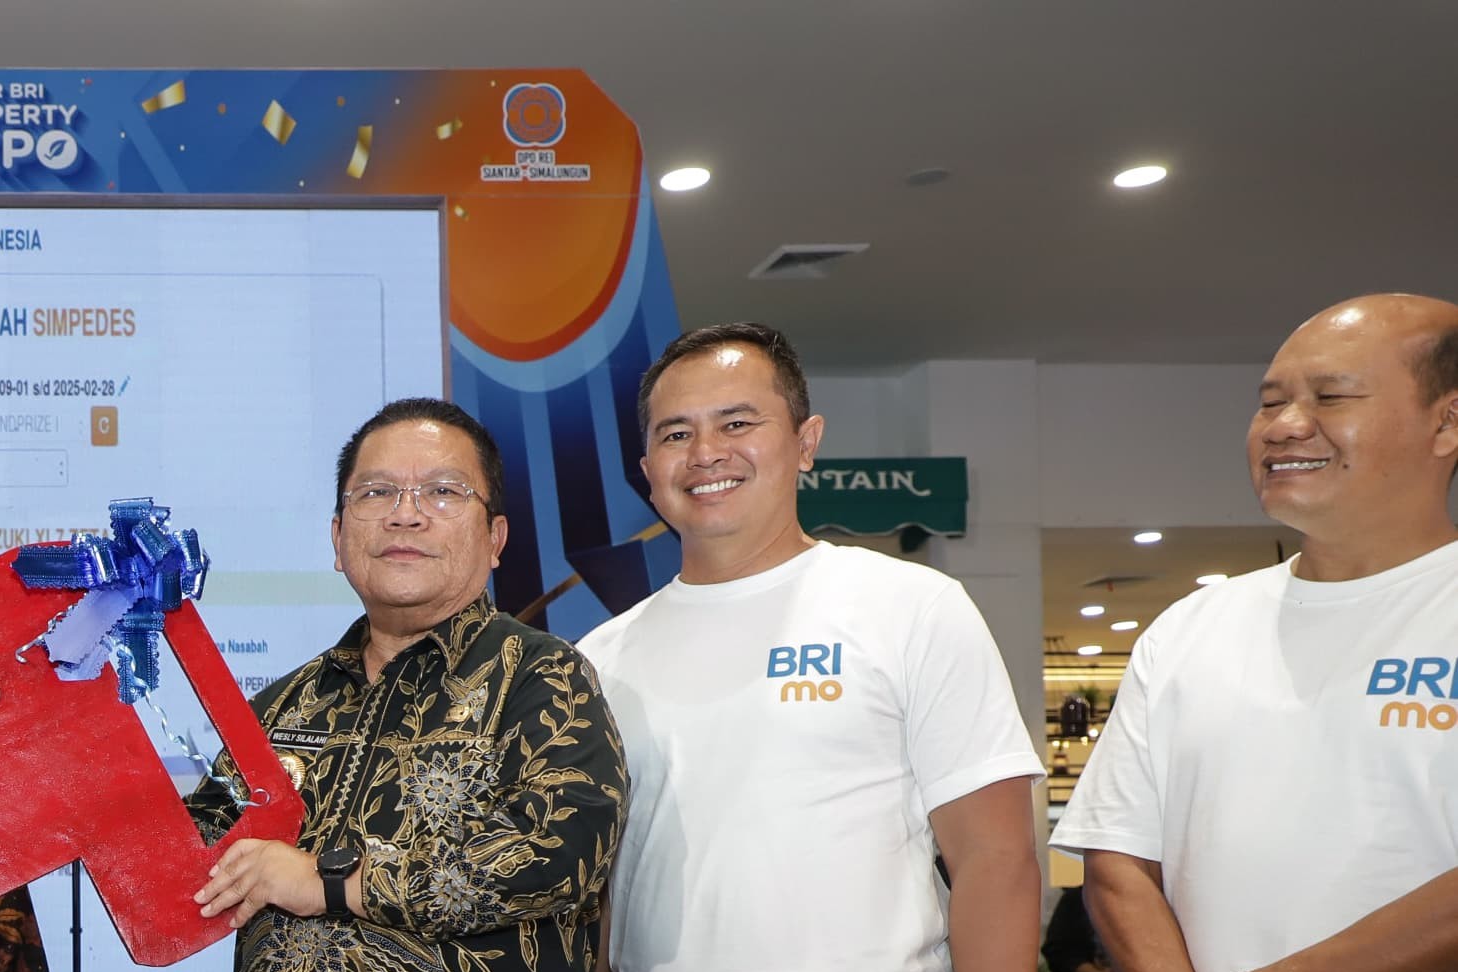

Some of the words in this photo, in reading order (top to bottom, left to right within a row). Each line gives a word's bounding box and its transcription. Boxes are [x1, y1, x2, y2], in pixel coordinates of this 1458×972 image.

[10, 83, 44, 98] BRI
[483, 167, 521, 178] SIANTAR
[529, 167, 589, 178] SIMALUNGUN
[33, 308, 136, 336] SIMPEDES
[53, 379, 115, 396] 2025-02-28
[228, 640, 269, 653] Nasabah
[767, 643, 842, 678] BRI
[1366, 657, 1458, 699] BRI
[781, 680, 842, 702] mo
[1380, 701, 1458, 731] mo
[272, 732, 297, 742] WESLY
[296, 734, 328, 744] SILALAHI
